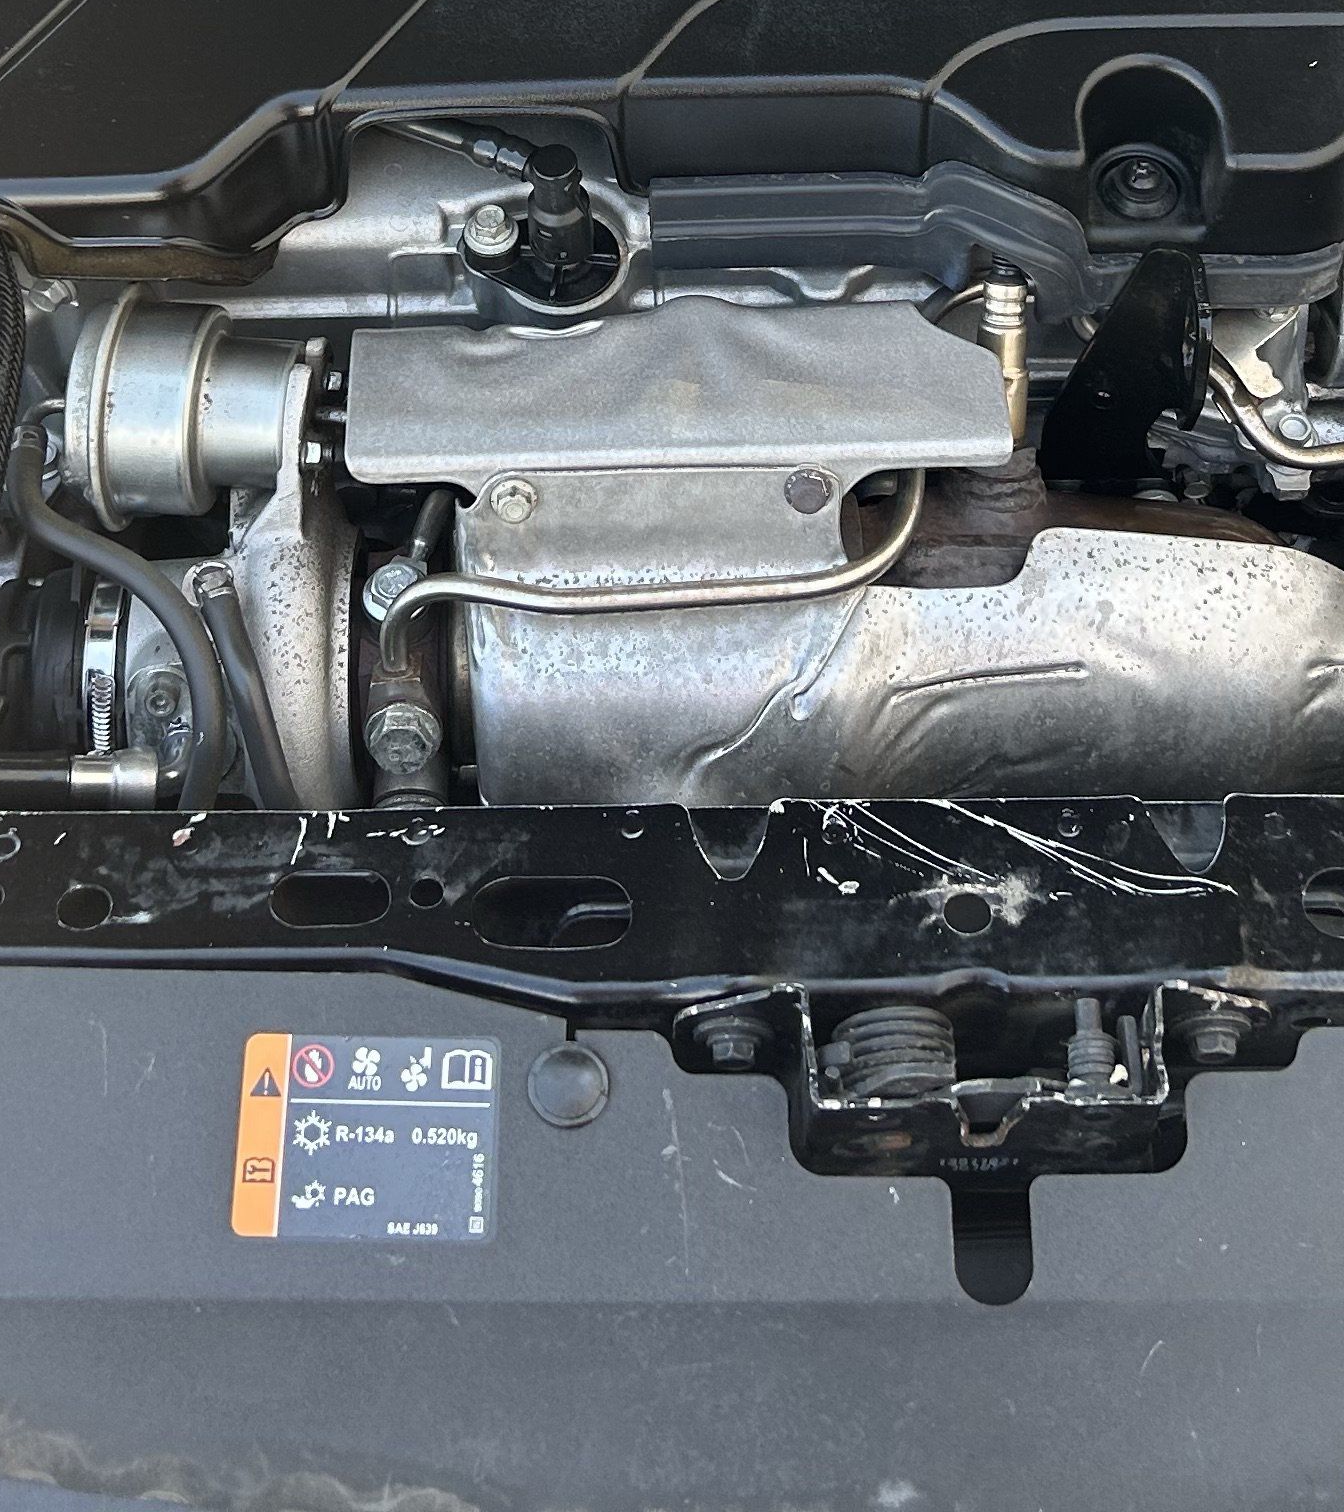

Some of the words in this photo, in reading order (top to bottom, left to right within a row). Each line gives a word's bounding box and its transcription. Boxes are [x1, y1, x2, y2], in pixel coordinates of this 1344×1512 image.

[347, 1074, 382, 1092] AUTO
[335, 1125, 395, 1144] R-134a
[411, 1126, 478, 1150] 0.520kg
[332, 1186, 376, 1207] PAG
[386, 1221, 411, 1235] SAE
